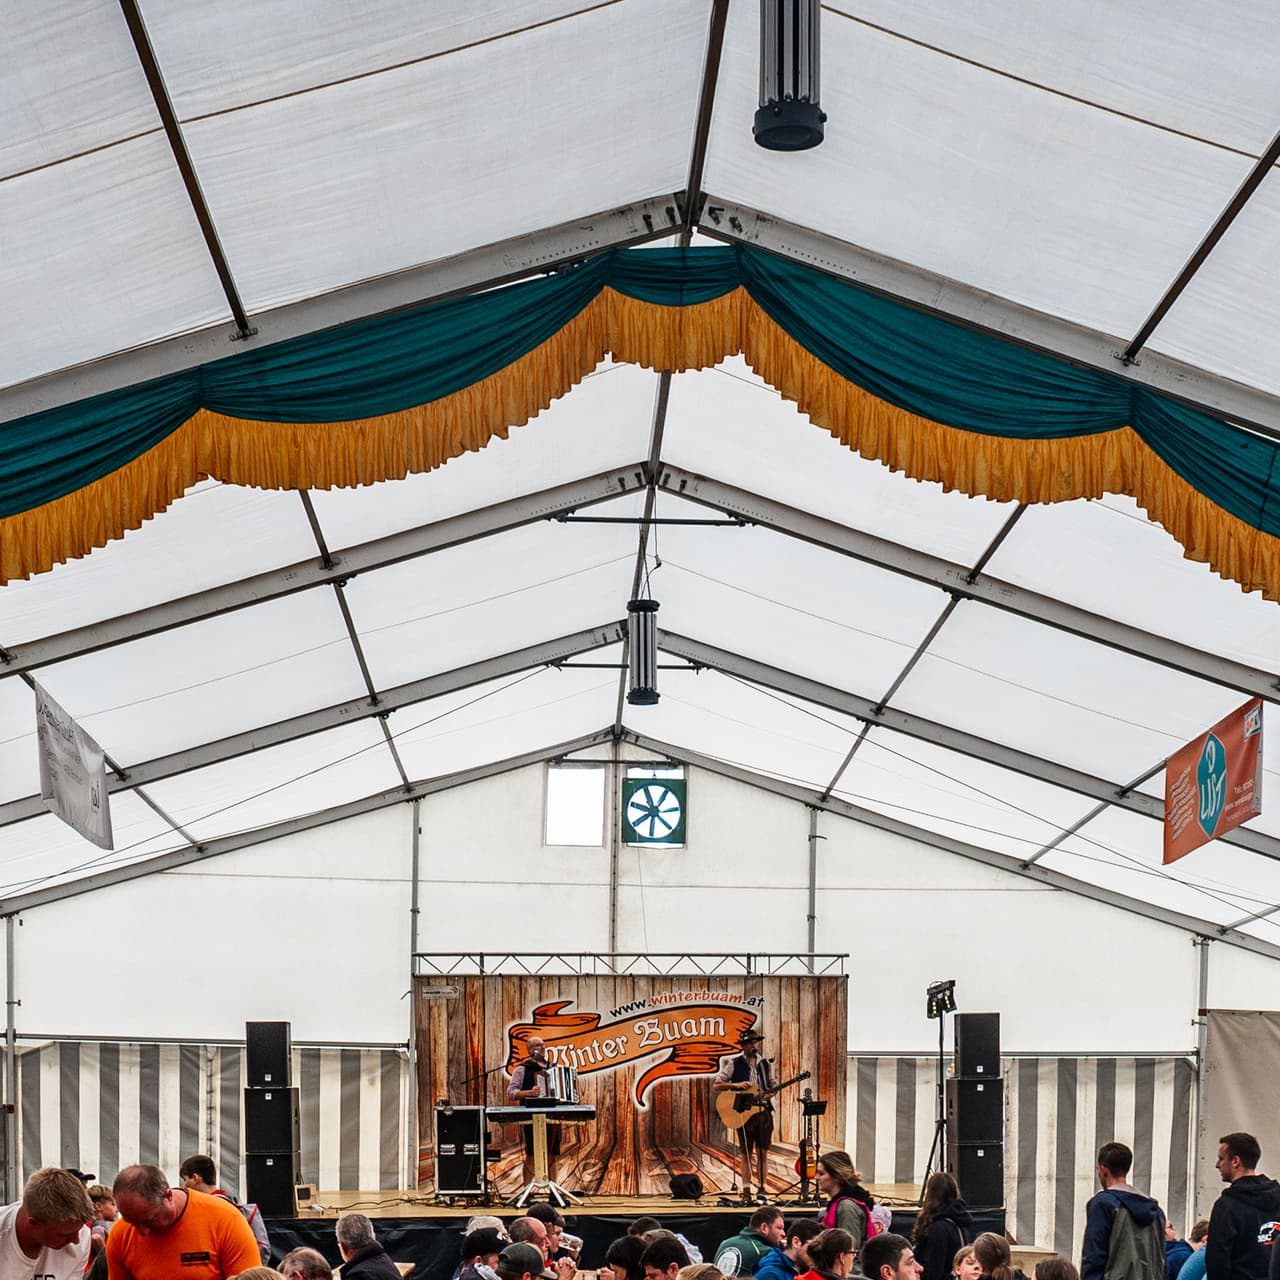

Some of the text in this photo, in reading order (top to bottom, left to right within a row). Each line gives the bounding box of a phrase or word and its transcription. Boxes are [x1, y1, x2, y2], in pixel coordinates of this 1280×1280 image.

[1200, 767, 1227, 820] LIST
[609, 990, 765, 1018] www.winterbuam.at
[633, 1015, 726, 1047] Buam
